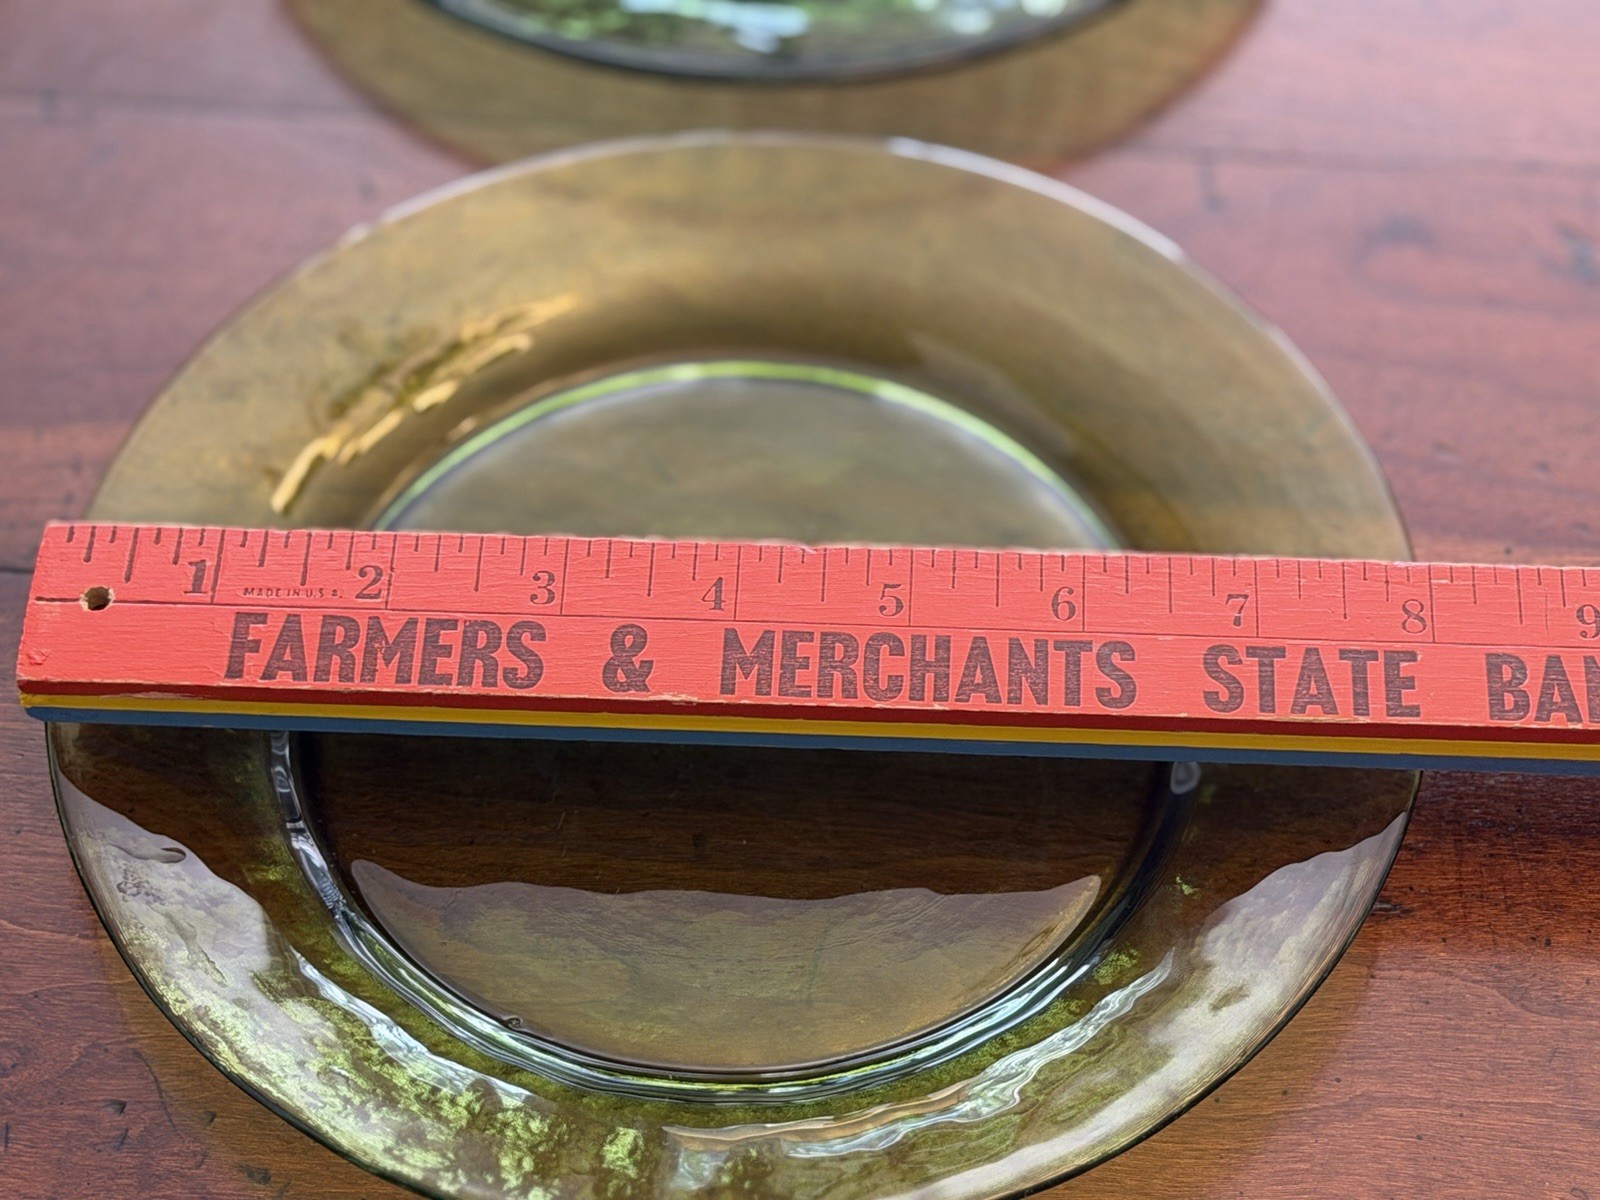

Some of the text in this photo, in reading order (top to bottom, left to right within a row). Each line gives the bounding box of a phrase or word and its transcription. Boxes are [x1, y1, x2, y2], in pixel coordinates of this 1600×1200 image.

[183, 559, 208, 594] 1
[243, 587, 281, 598] MADE
[286, 588, 300, 597] IN
[355, 564, 384, 600] 2
[530, 570, 556, 605] 3
[702, 577, 726, 611] 4
[879, 583, 904, 617] 5
[1051, 586, 1076, 621] 6
[1225, 593, 1249, 627] 7
[1402, 599, 1427, 633] 8
[1576, 604, 1600, 639] 9
[223, 611, 547, 689] FARMERS
[602, 624, 654, 693] &
[720, 627, 1137, 709] MERCHANTS
[1202, 644, 1421, 718] STATE
